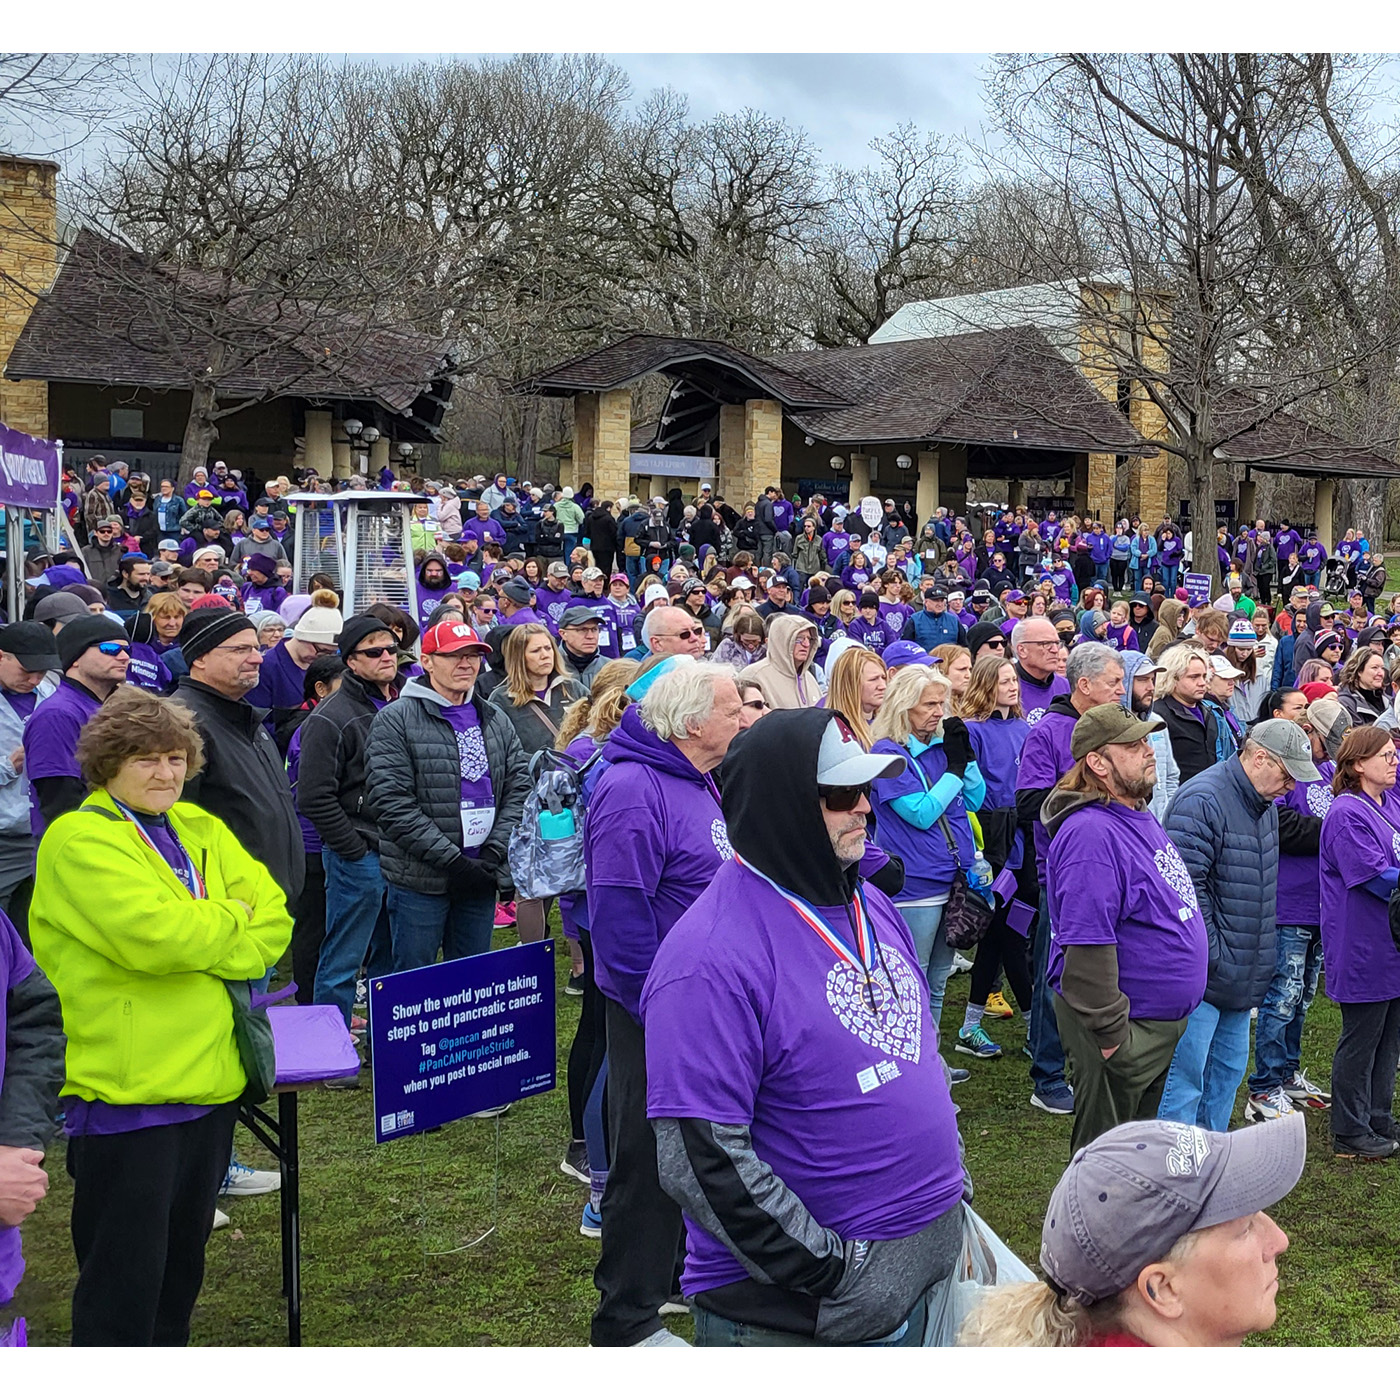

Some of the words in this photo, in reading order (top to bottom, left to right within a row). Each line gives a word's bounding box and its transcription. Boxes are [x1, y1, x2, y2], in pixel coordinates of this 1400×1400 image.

[387, 1024, 416, 1042] steps
[419, 1020, 429, 1033] to
[431, 1012, 451, 1030] end
[453, 1000, 506, 1028] pancreatic
[508, 992, 543, 1010] cancer.
[392, 1002, 421, 1021] Show
[424, 998, 441, 1013] the
[443, 989, 472, 1008] world
[474, 982, 505, 1005] you're
[507, 974, 538, 992] taking
[419, 1037, 515, 1073] #PanCANPurpleStride
[421, 1043, 436, 1057] Tag
[439, 1031, 480, 1050] @pancan
[481, 1024, 497, 1040] and
[499, 1022, 514, 1035] use
[403, 1078, 427, 1095] when
[429, 1075, 445, 1090] you
[447, 1068, 466, 1085] post
[467, 1064, 476, 1076] to
[478, 1056, 502, 1073] social
[504, 1049, 531, 1065] media.
[854, 1239, 868, 1270] VIK
